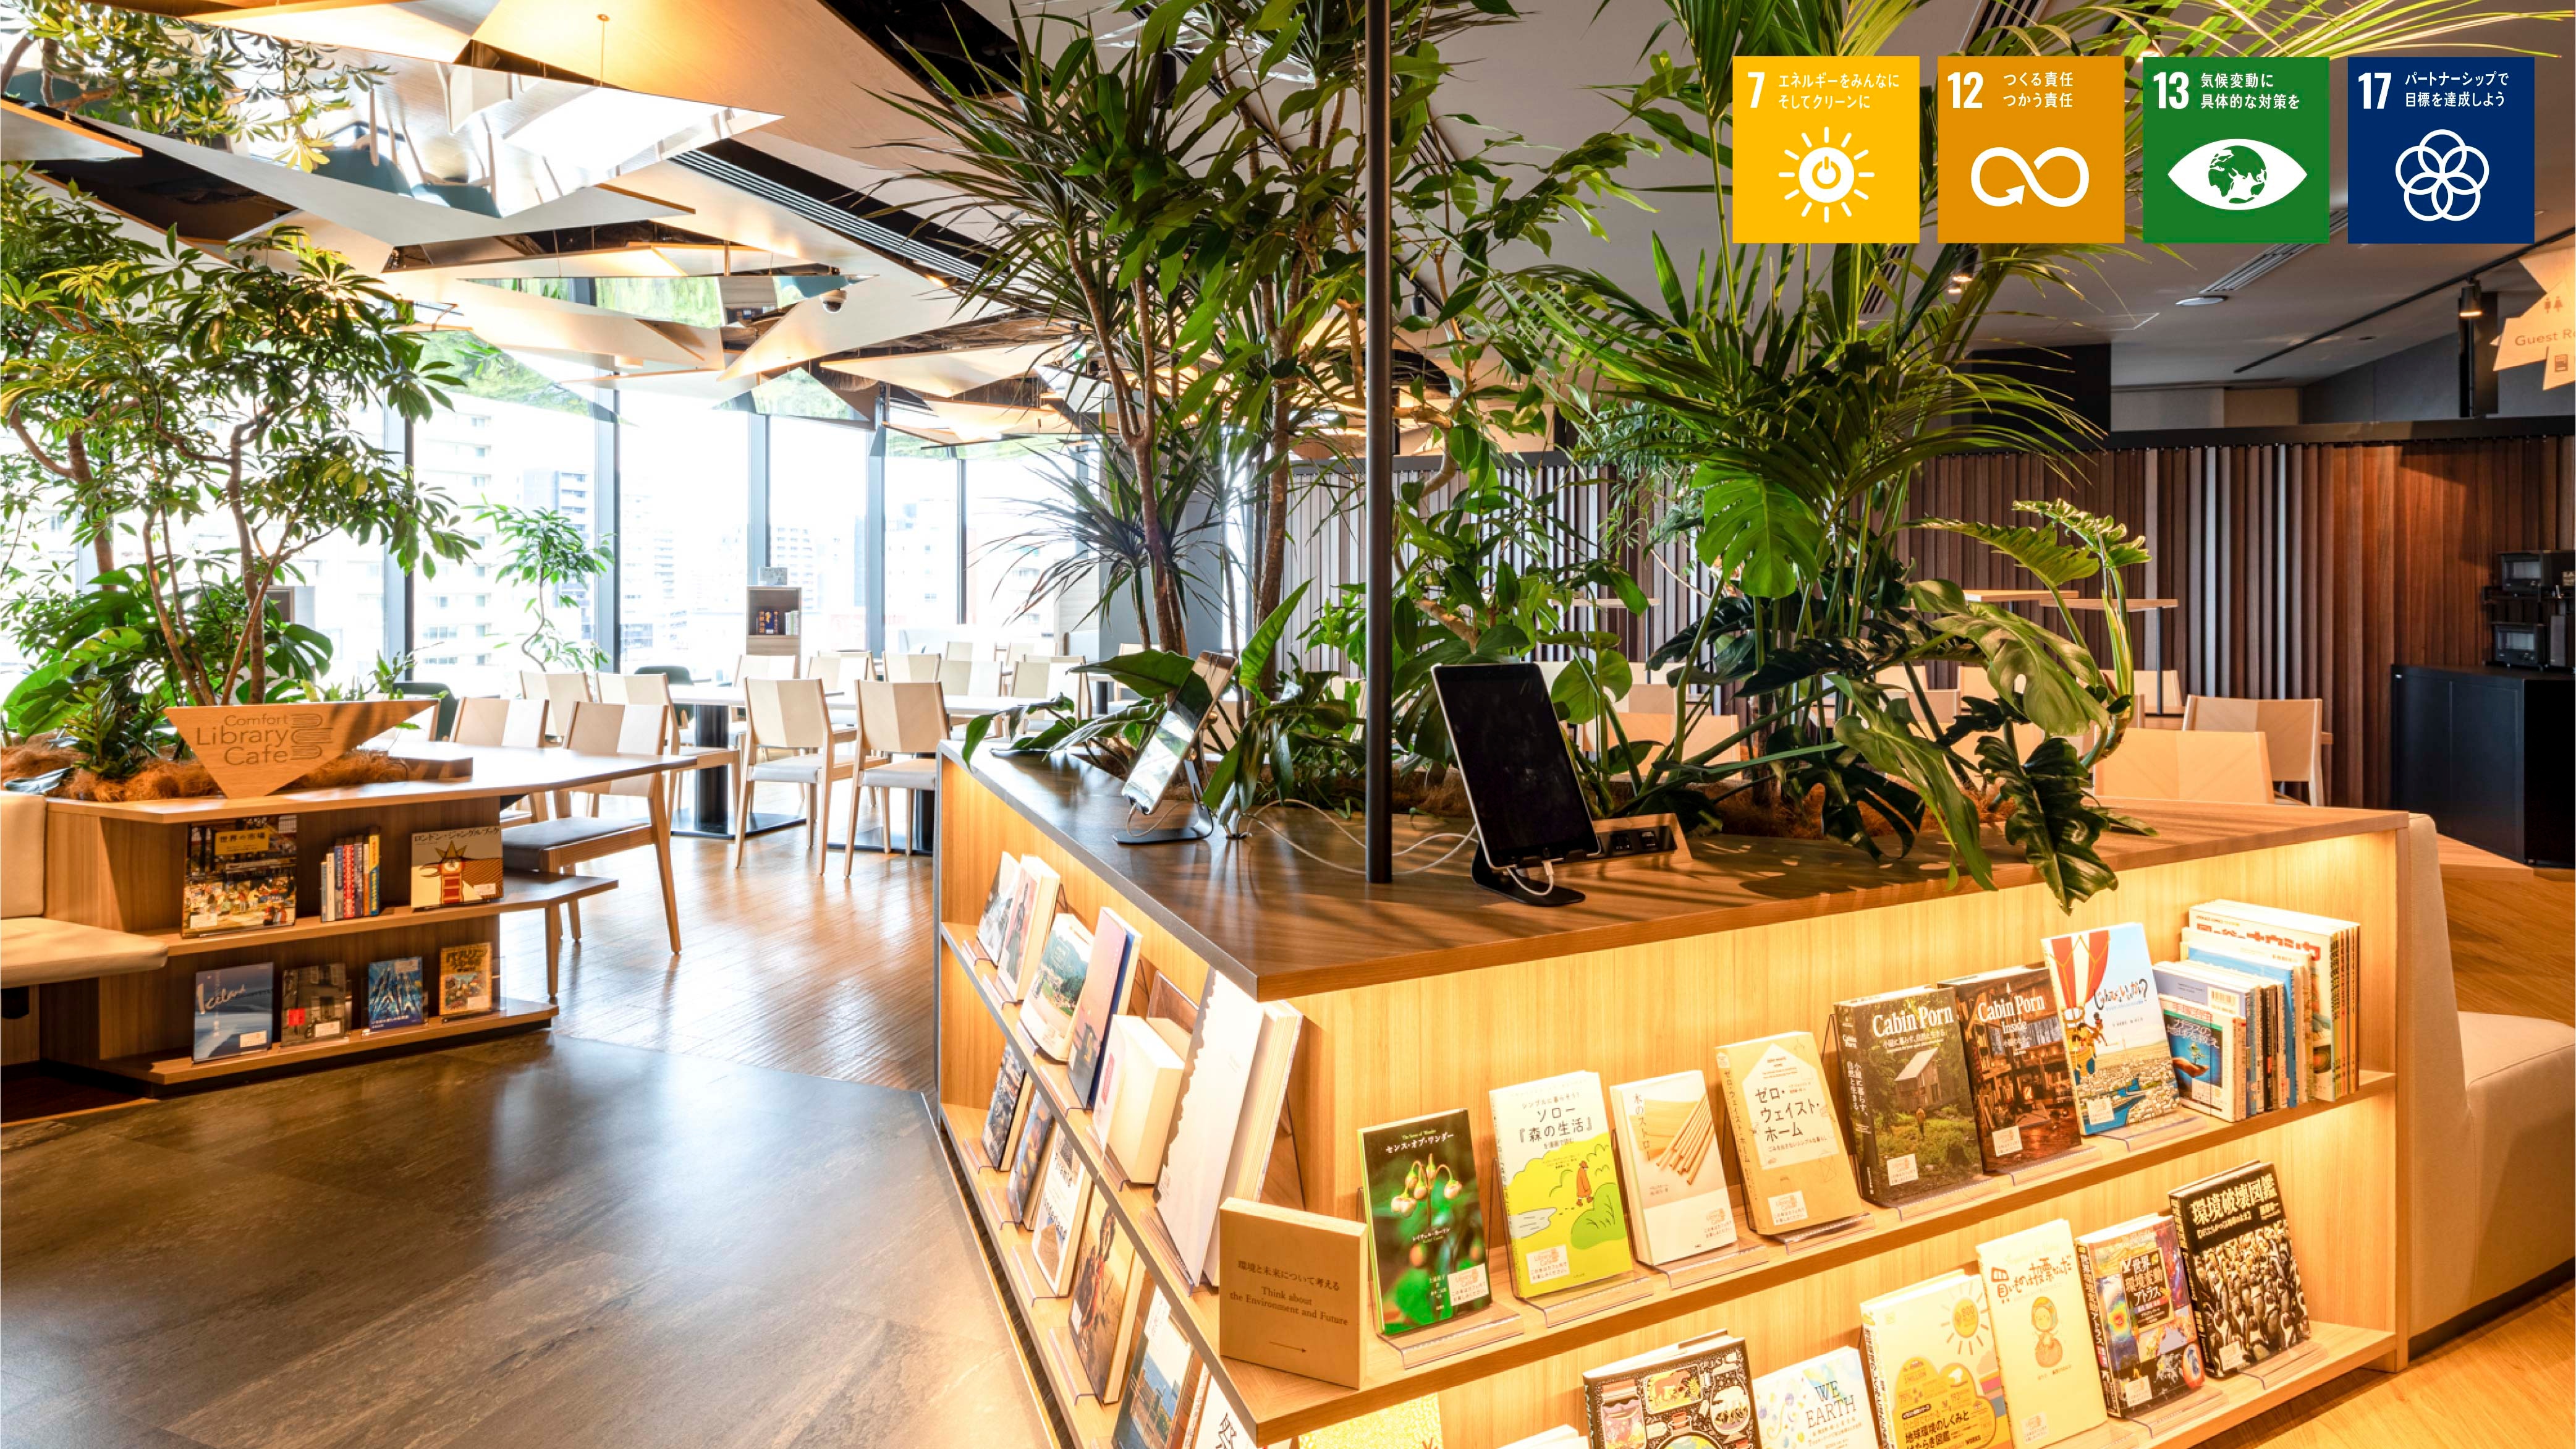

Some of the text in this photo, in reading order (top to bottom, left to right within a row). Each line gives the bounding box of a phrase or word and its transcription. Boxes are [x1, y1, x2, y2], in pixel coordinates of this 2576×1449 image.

[2515, 331, 2559, 346] Guest
[224, 713, 289, 727] Comfort
[197, 725, 289, 747] Library
[224, 744, 289, 766] Cafe
[1978, 995, 2046, 1022] Cabin Porn
[1873, 1006, 1954, 1037] Cabin Porn
[2001, 1018, 2027, 1034] Inside
[1537, 1107, 1576, 1123] ソロー
[1519, 1116, 1593, 1143] 『森の生活』
[1765, 1121, 1803, 1142] ホーム
[2190, 1173, 2277, 1226] 環境破壊図鑑
[1237, 1259, 1341, 1291] 環境と未来について考える
[1261, 1286, 1313, 1306] Think about
[1229, 1291, 1349, 1326] the Environment and Future
[1815, 1380, 1840, 1402] WE
[1806, 1395, 1857, 1429] EARTH
